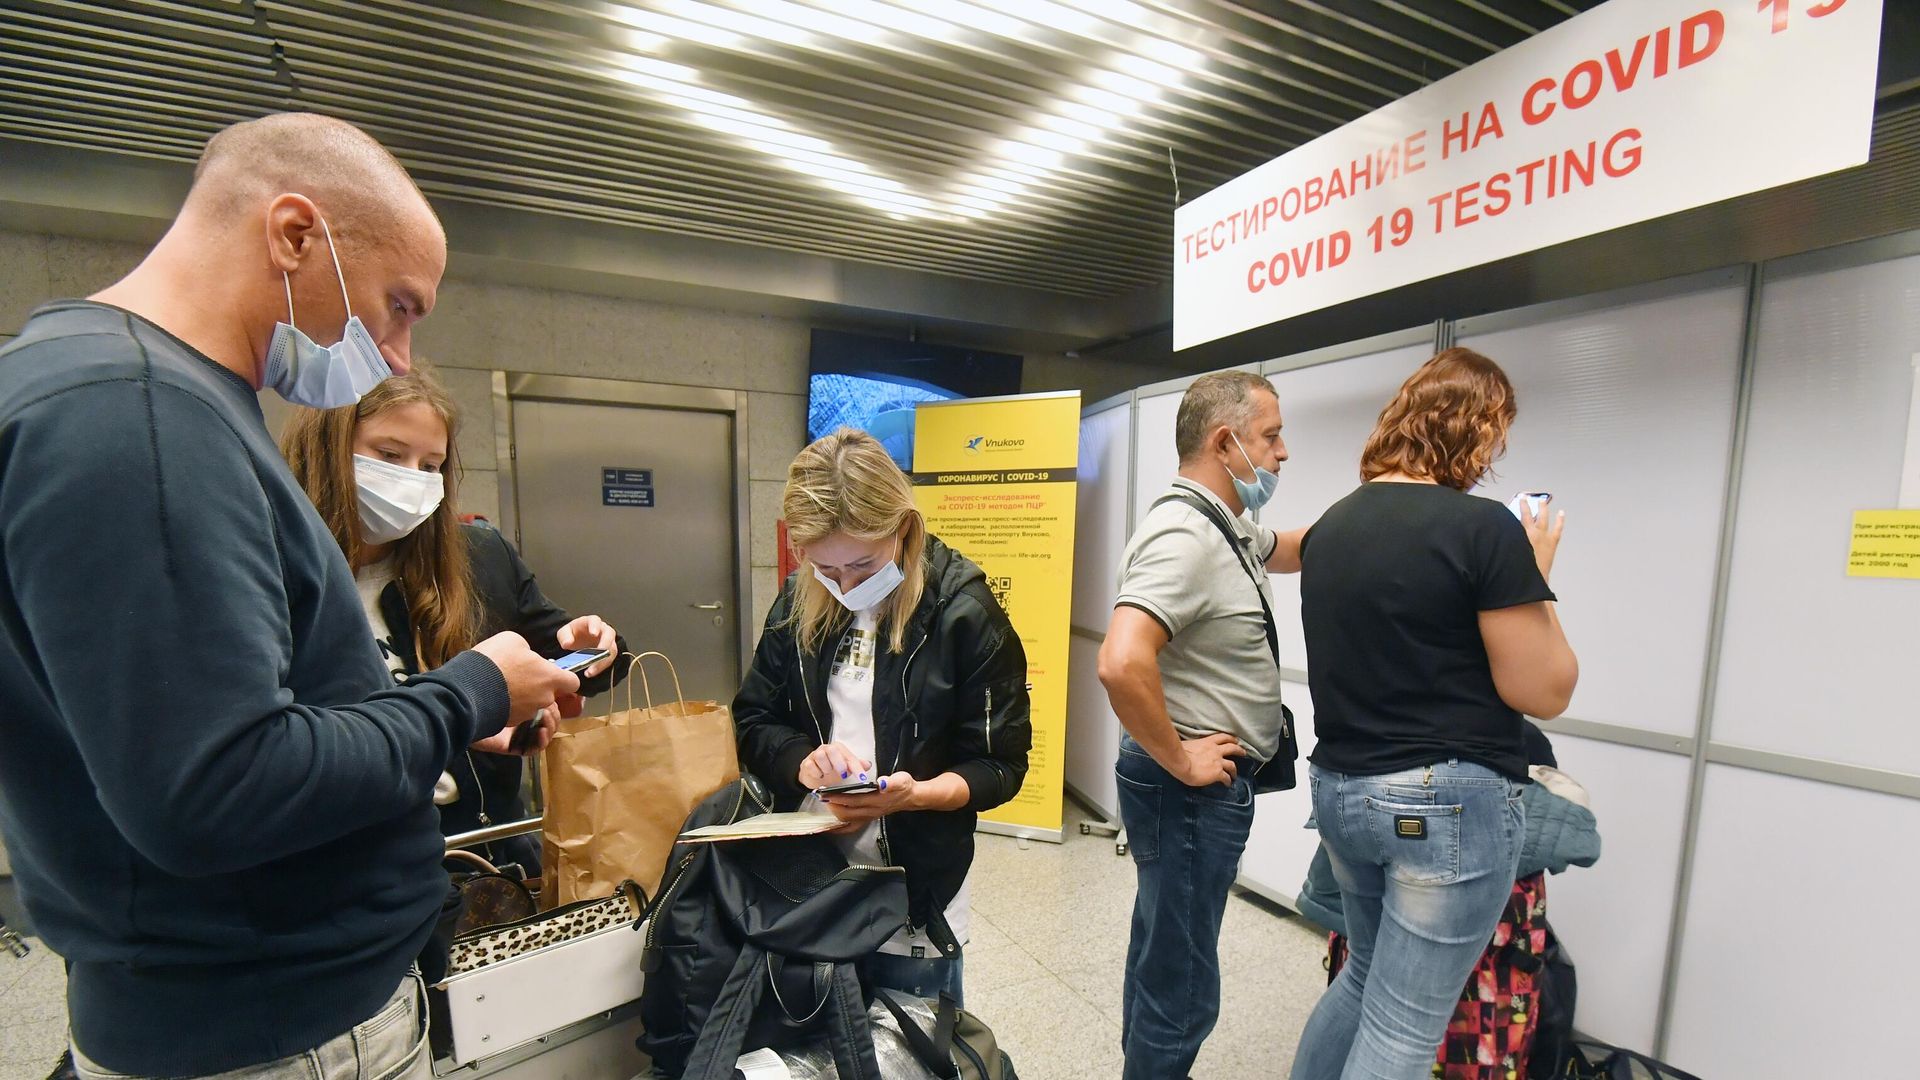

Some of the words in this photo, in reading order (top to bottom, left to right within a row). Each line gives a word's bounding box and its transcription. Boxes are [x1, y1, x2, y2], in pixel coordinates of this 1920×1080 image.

[1182, 130, 1426, 263] ТЕСТИРОВАНИЕ
[1442, 101, 1504, 160] НА
[1521, 9, 1725, 126] COVID
[1247, 230, 1352, 293] COVID
[1367, 207, 1414, 254] 19
[1428, 128, 1642, 234] TESTING
[985, 439, 1025, 448] Vnukovo
[938, 474, 998, 483] КОРОНАВИРУС
[1007, 472, 1049, 481] COVID-19
[943, 494, 1041, 502] Экспресс-исследование
[948, 503, 987, 511] COVID-19
[988, 502, 1024, 510] методом
